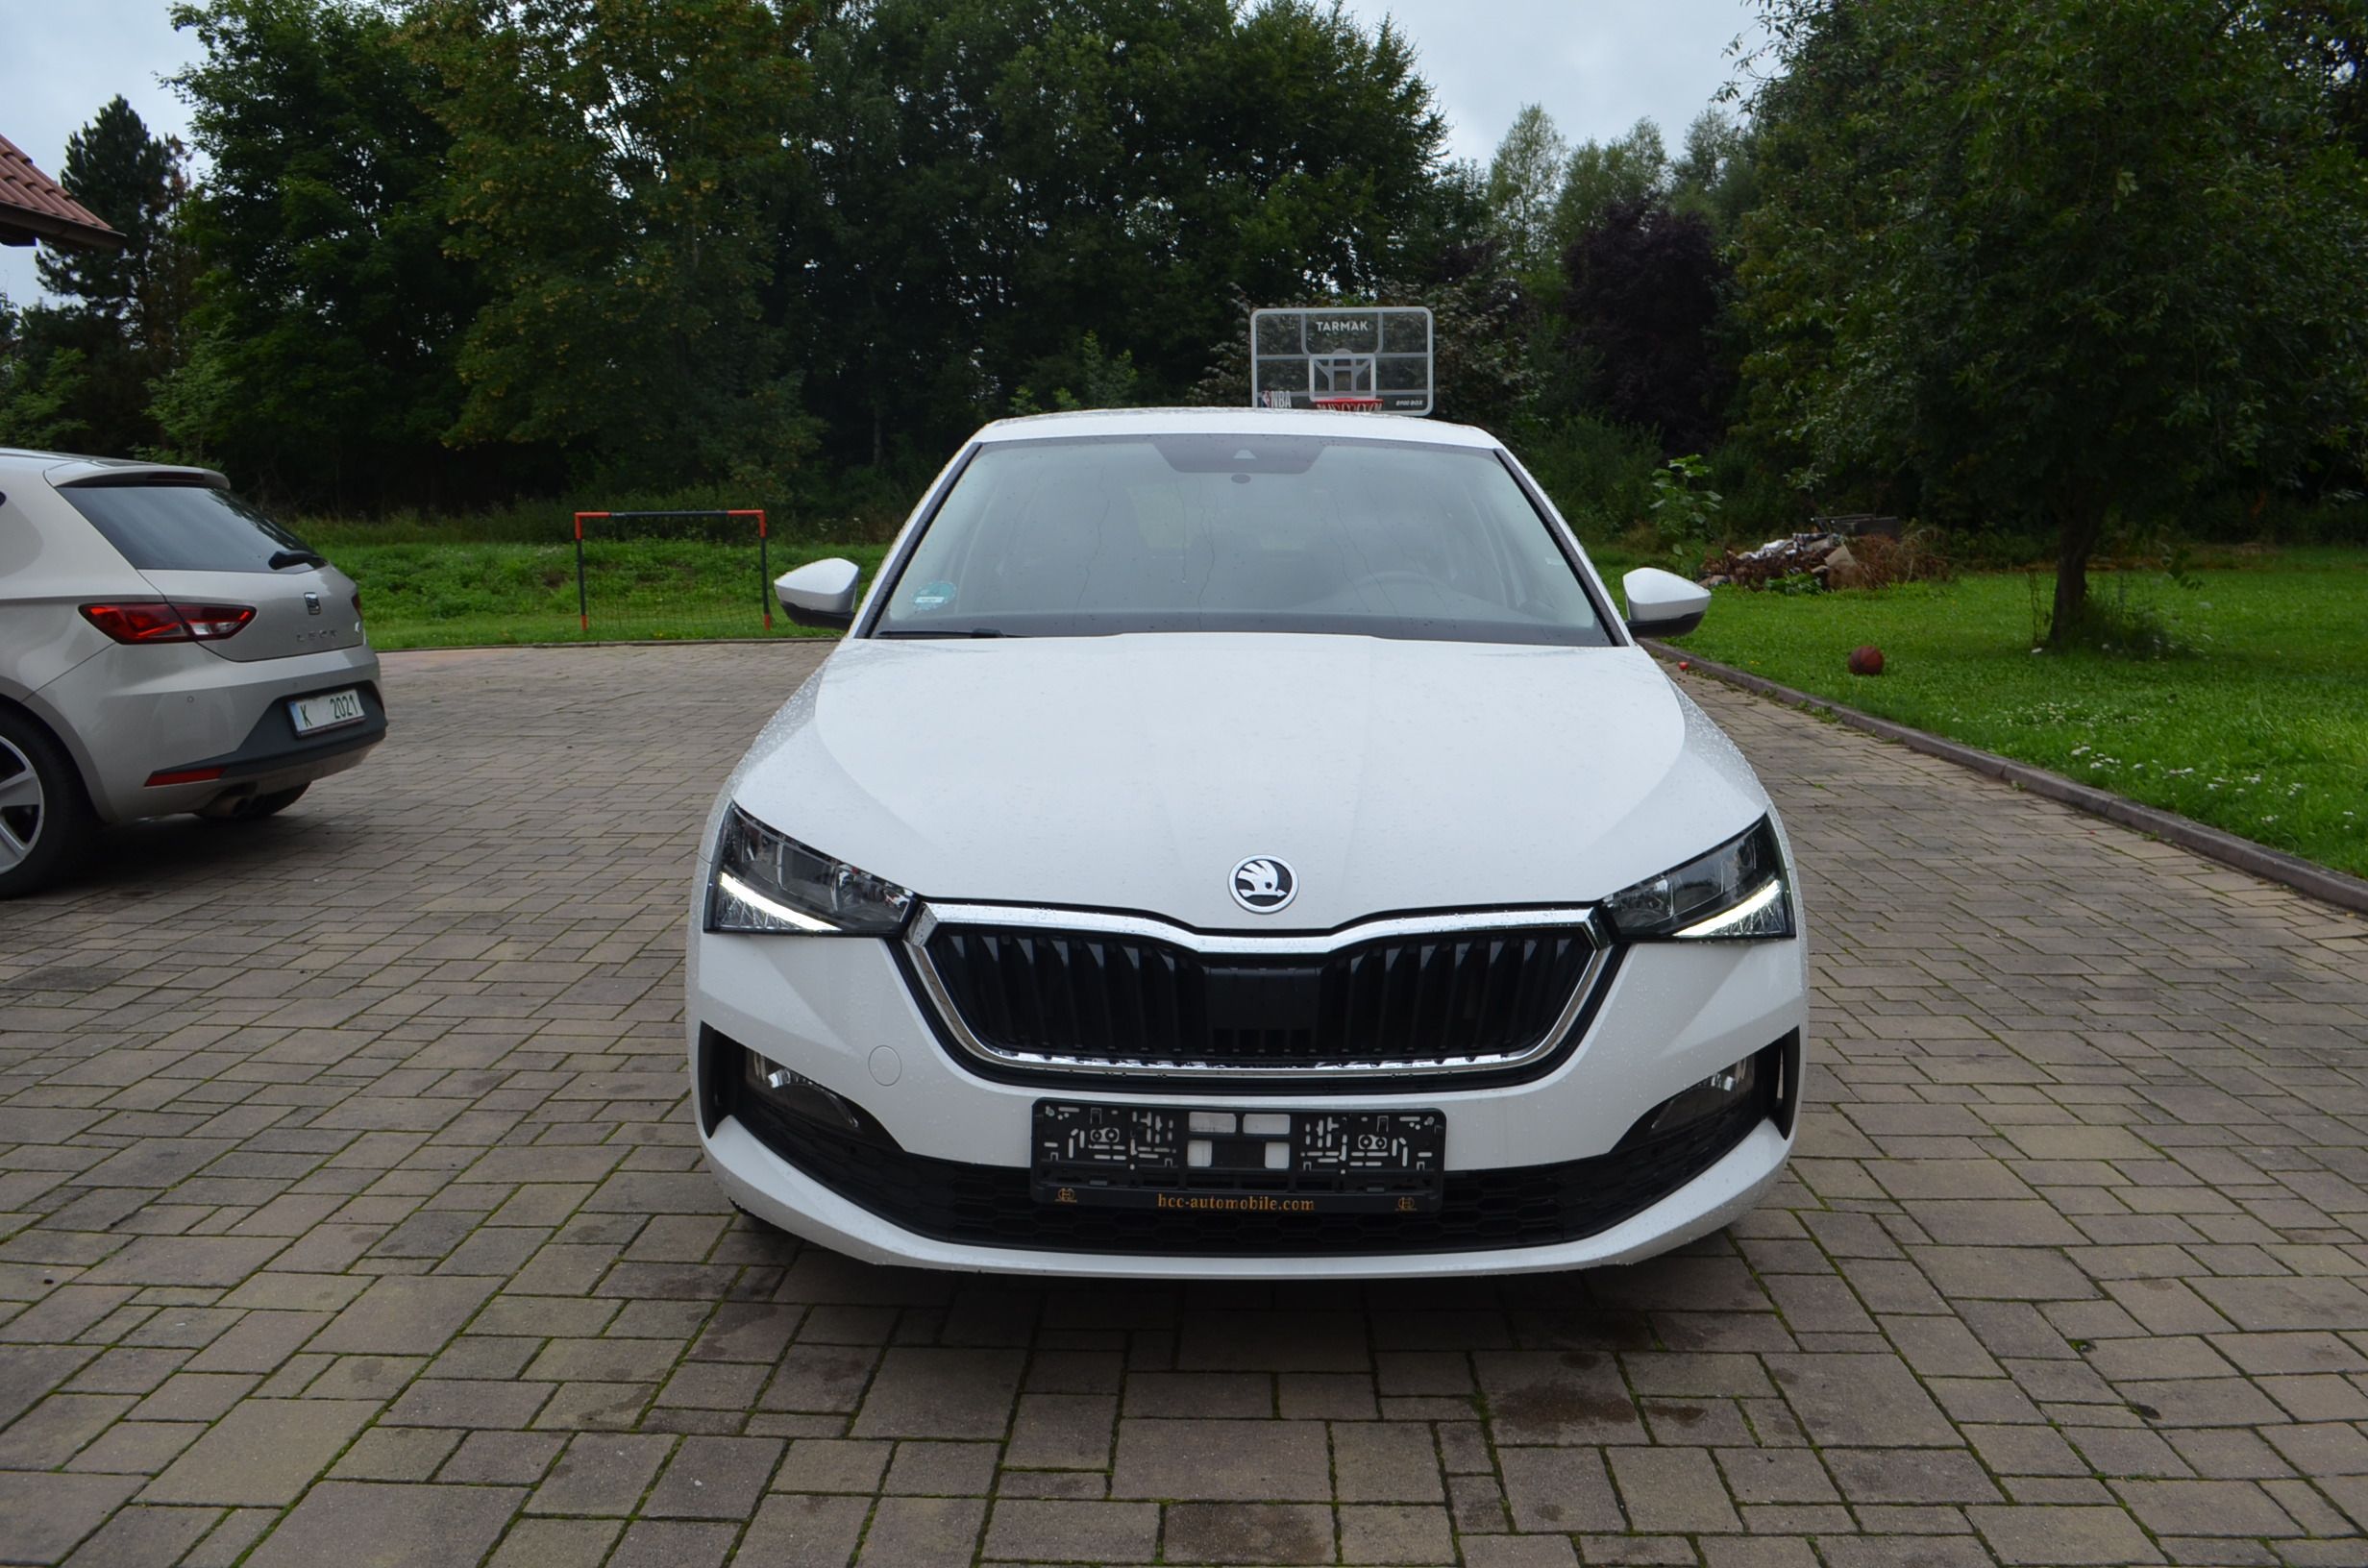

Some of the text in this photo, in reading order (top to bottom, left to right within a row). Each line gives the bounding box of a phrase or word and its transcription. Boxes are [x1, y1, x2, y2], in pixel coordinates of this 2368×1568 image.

[1316, 320, 1369, 332] TARMAK
[1270, 390, 1292, 408] NBA
[300, 694, 358, 727] K 2021
[1157, 1192, 1316, 1211] hcc-automobile.com
